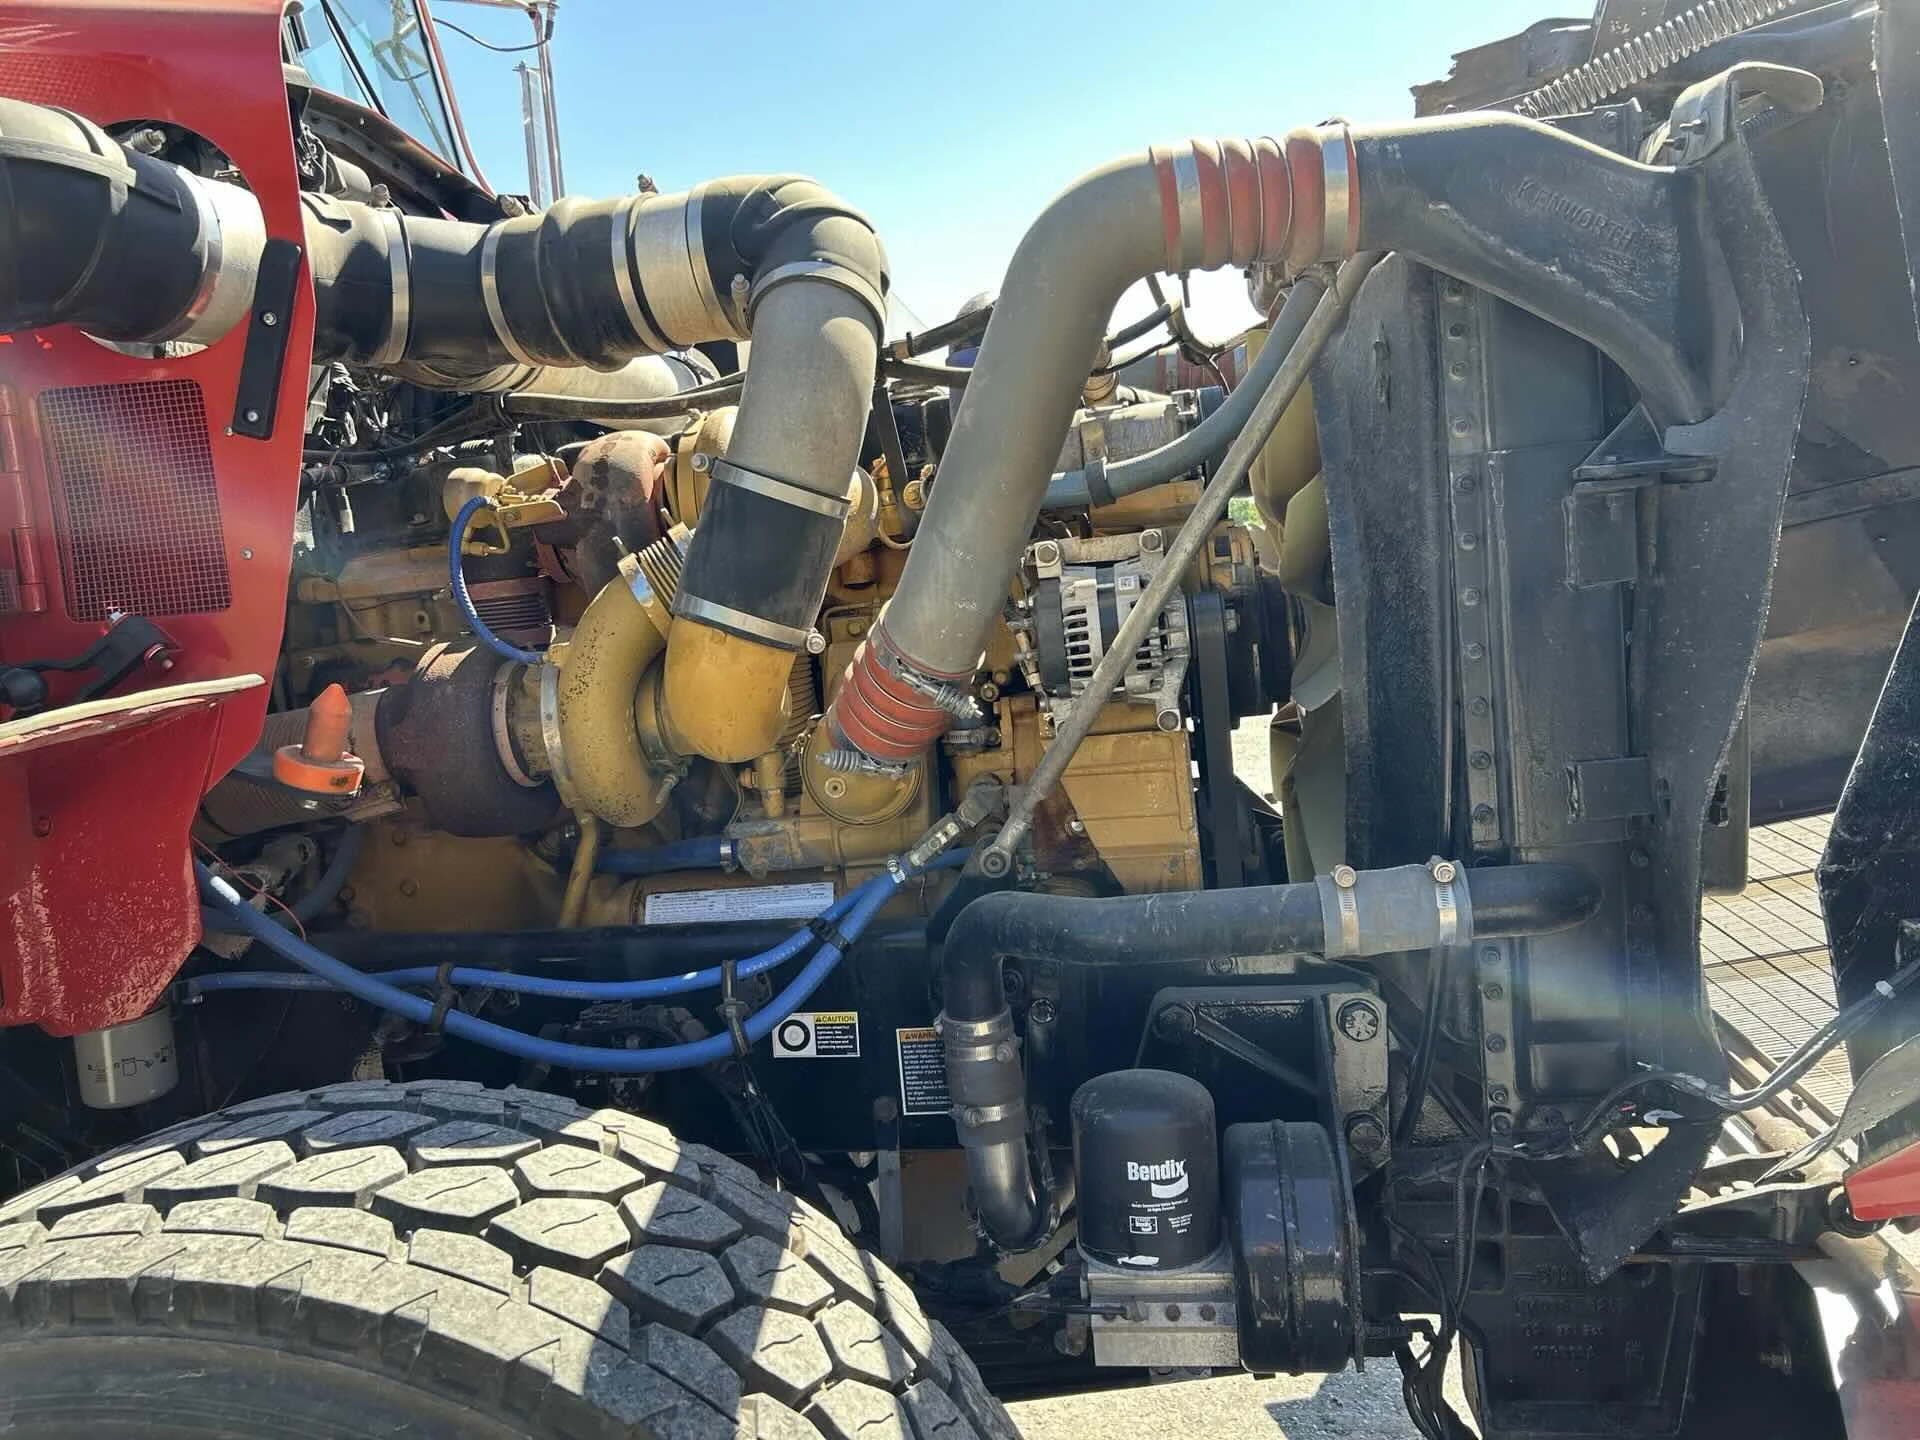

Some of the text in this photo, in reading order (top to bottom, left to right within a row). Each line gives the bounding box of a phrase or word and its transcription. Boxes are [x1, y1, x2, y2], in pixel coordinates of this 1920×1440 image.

[1517, 176, 1634, 249] KENWORTH
[821, 1015, 855, 1023] CAUTION
[910, 1031, 937, 1040] WARN
[1127, 1159, 1185, 1181] Bendix
